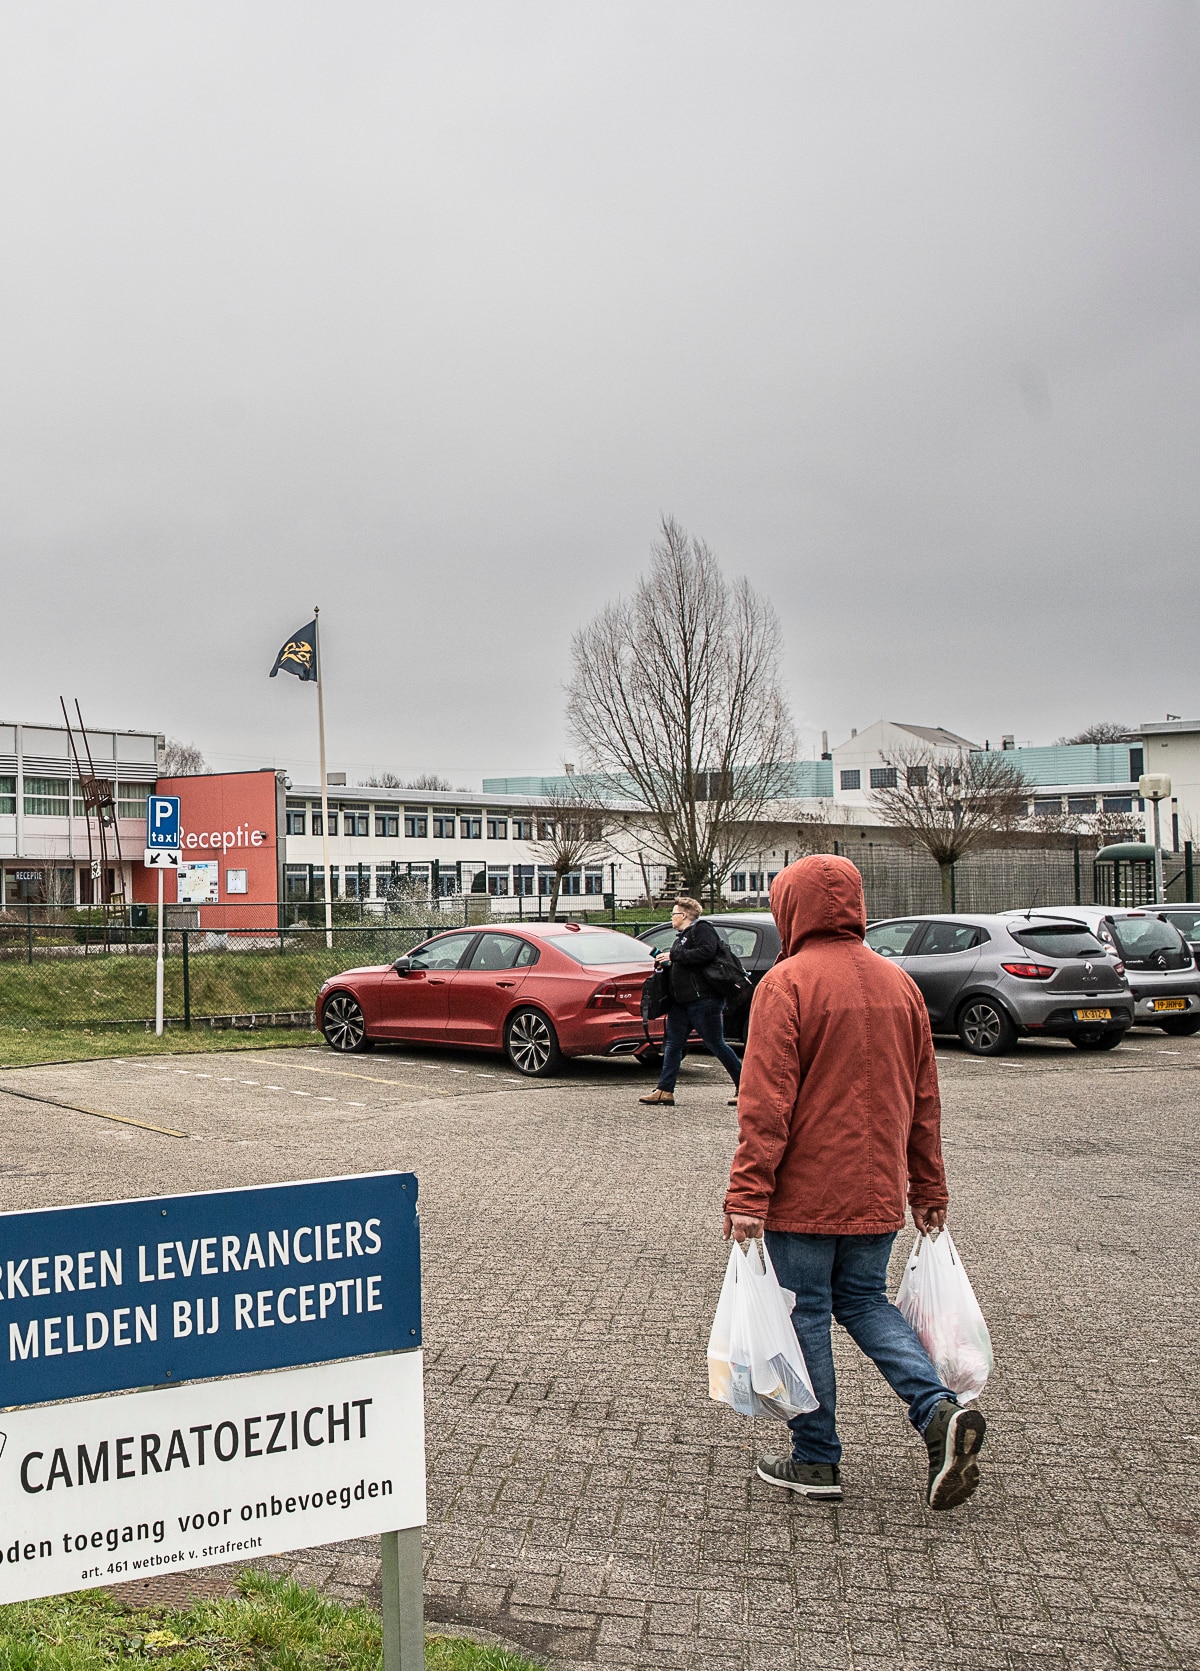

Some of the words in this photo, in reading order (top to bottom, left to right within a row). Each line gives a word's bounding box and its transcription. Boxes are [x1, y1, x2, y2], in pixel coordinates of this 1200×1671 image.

[155, 801, 173, 828] P
[151, 832, 177, 843] taxi
[16, 871, 42, 880] RECEPTIE
[1081, 1009, 1107, 1018] JK-312-P
[138, 1218, 382, 1283] LEVERANCIERS
[9, 1304, 158, 1362] MELDEN
[173, 1296, 219, 1338] BIJ
[234, 1275, 383, 1331] RECEPTIE
[20, 1398, 372, 1494] CAMERATOEZICHT
[62, 1520, 165, 1553] toegang
[178, 1507, 232, 1533] voor
[240, 1479, 393, 1521] onbevoegden
[81, 1566, 103, 1580] art.
[106, 1561, 128, 1574] 461
[132, 1550, 185, 1569] wetboek
[188, 1550, 198, 1560] v.
[202, 1536, 263, 1557] strafrecht
